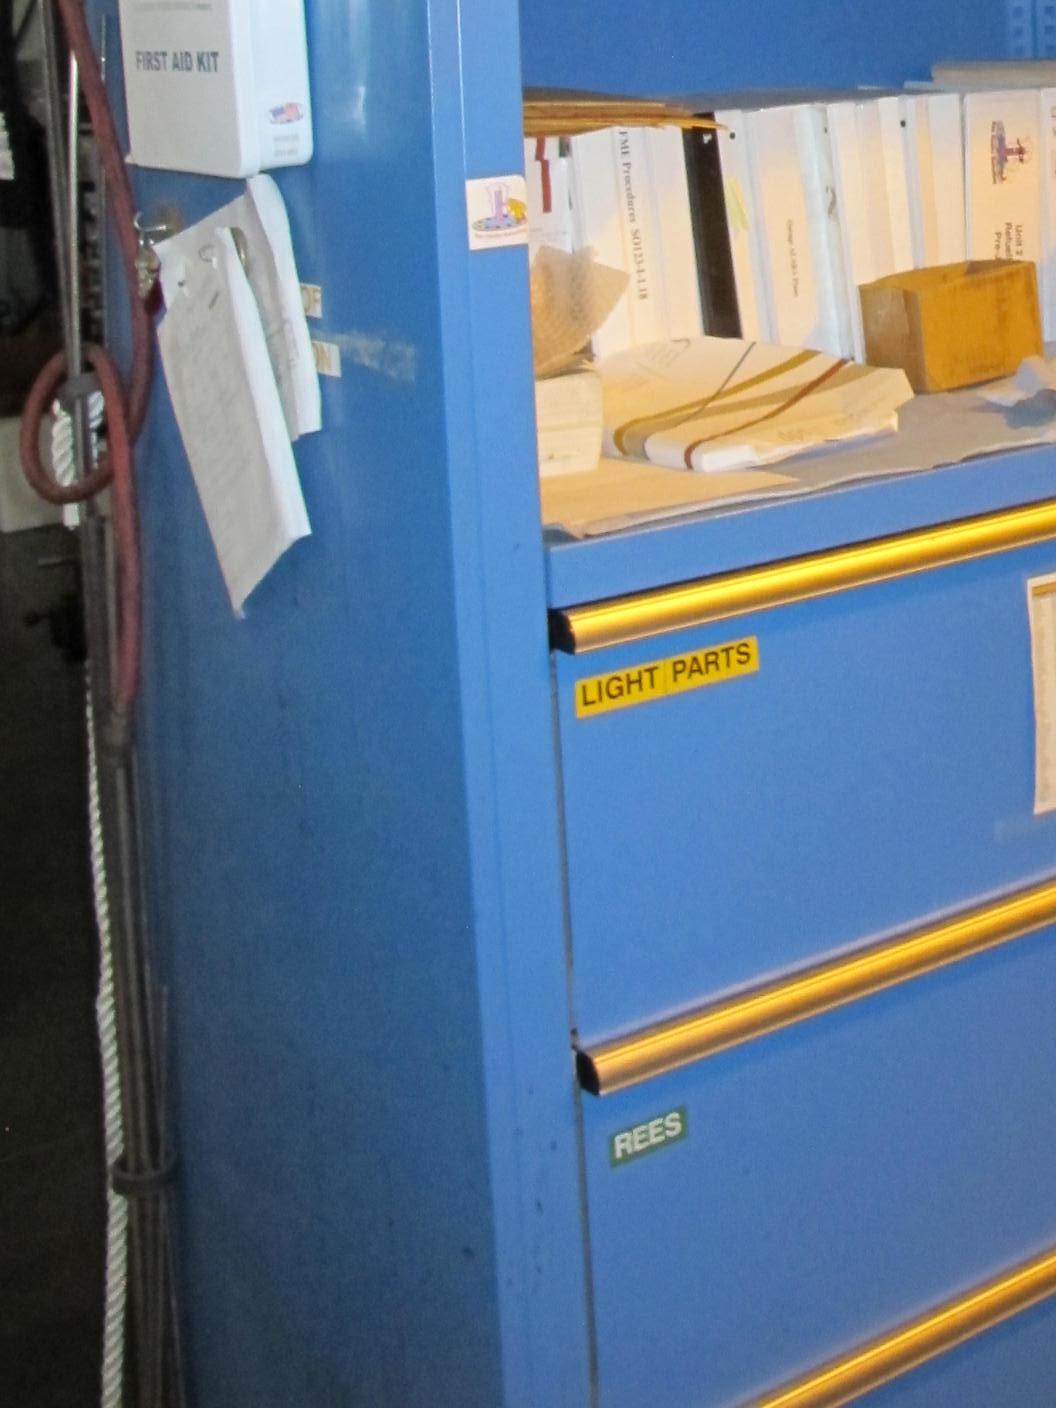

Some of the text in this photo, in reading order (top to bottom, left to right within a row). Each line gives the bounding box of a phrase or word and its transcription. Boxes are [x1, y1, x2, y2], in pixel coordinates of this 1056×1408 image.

[136, 50, 219, 73] FIRST AID KIT
[622, 162, 636, 224] Procedures
[581, 642, 752, 706] LIGHT PARTS
[614, 1111, 682, 1159] REES
